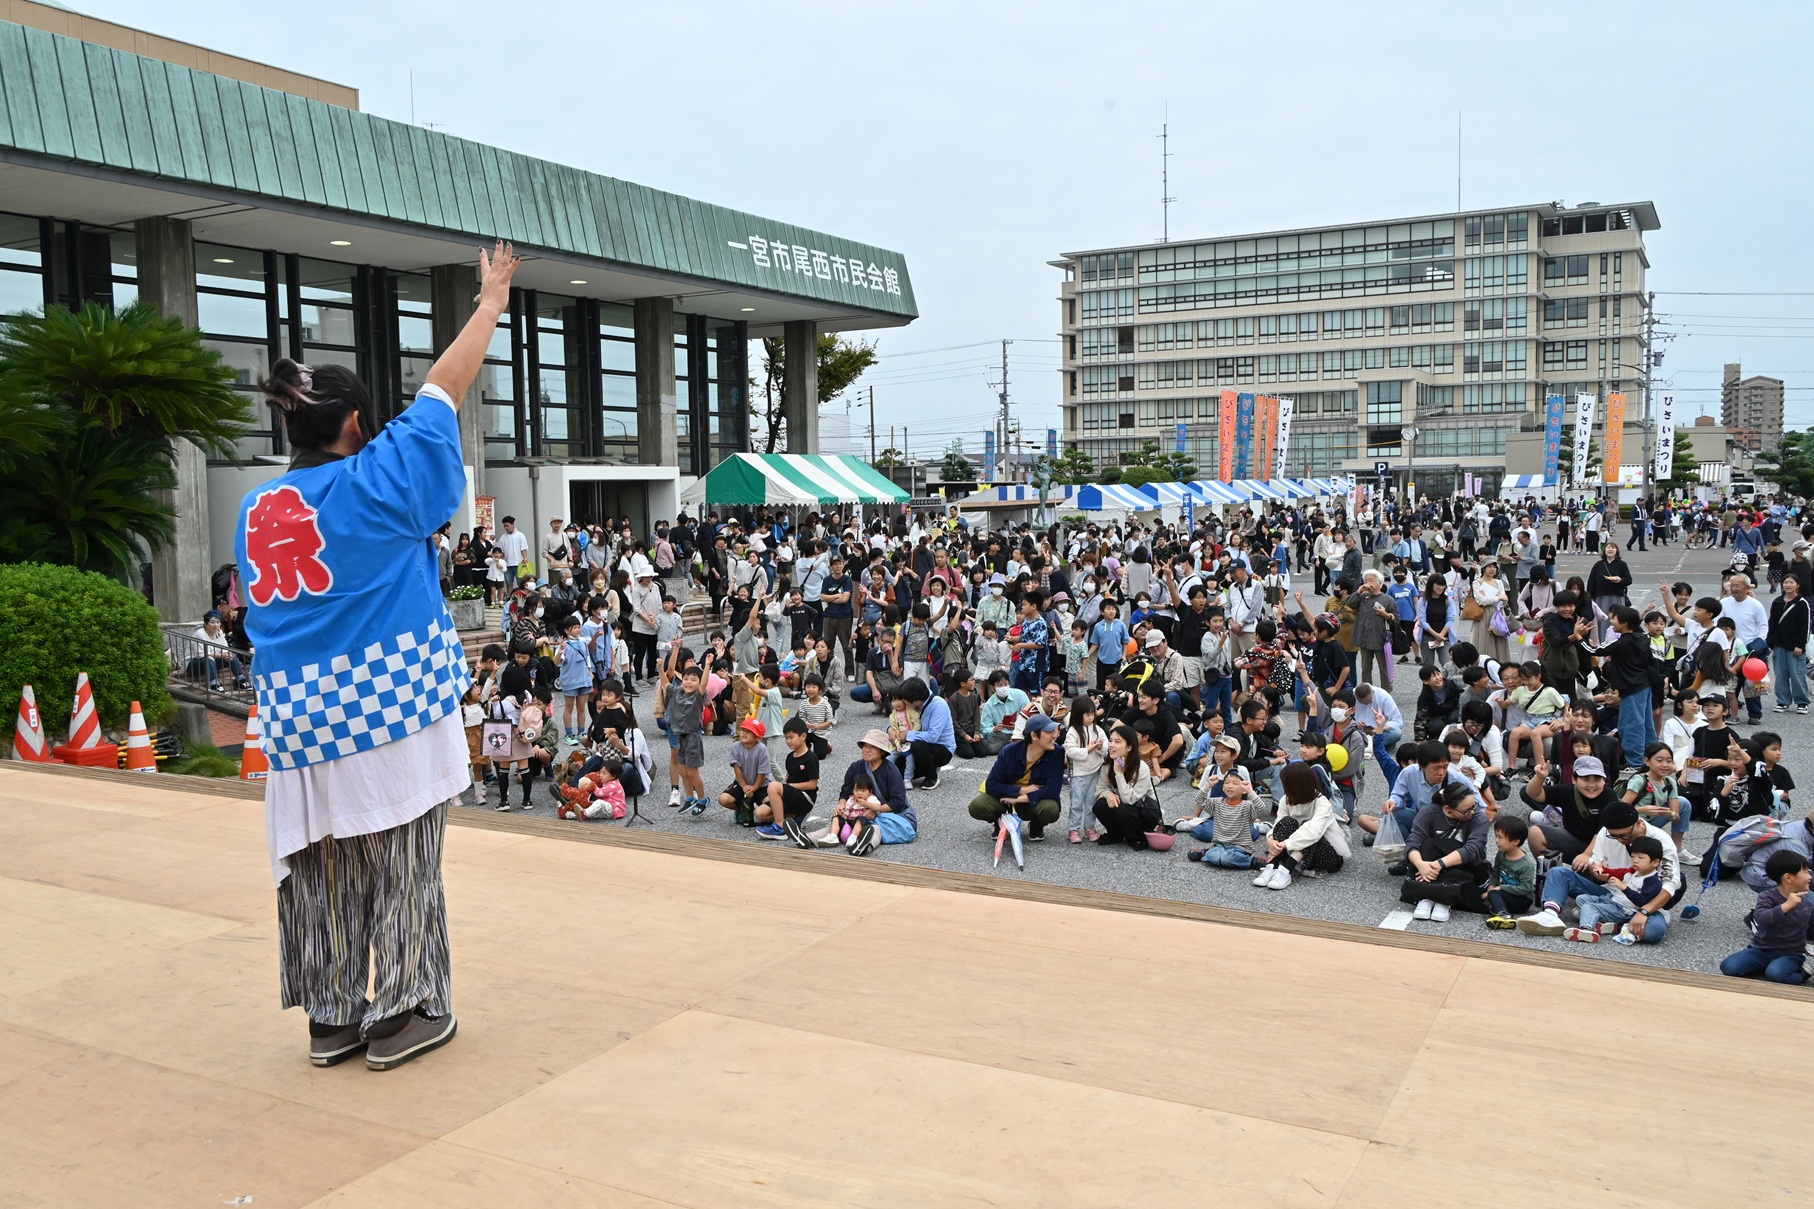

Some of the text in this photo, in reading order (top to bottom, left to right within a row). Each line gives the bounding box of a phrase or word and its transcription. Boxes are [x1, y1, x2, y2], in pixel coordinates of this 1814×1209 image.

[727, 234, 901, 296] 一宮市尾西市民会館
[1222, 399, 1233, 479] びさいまつり
[1377, 463, 1386, 474] P
[1547, 402, 1561, 476] びさいまつり
[1608, 399, 1621, 475] びさいまつり
[1660, 396, 1673, 474] びさいまつり
[246, 485, 334, 607] 祭
